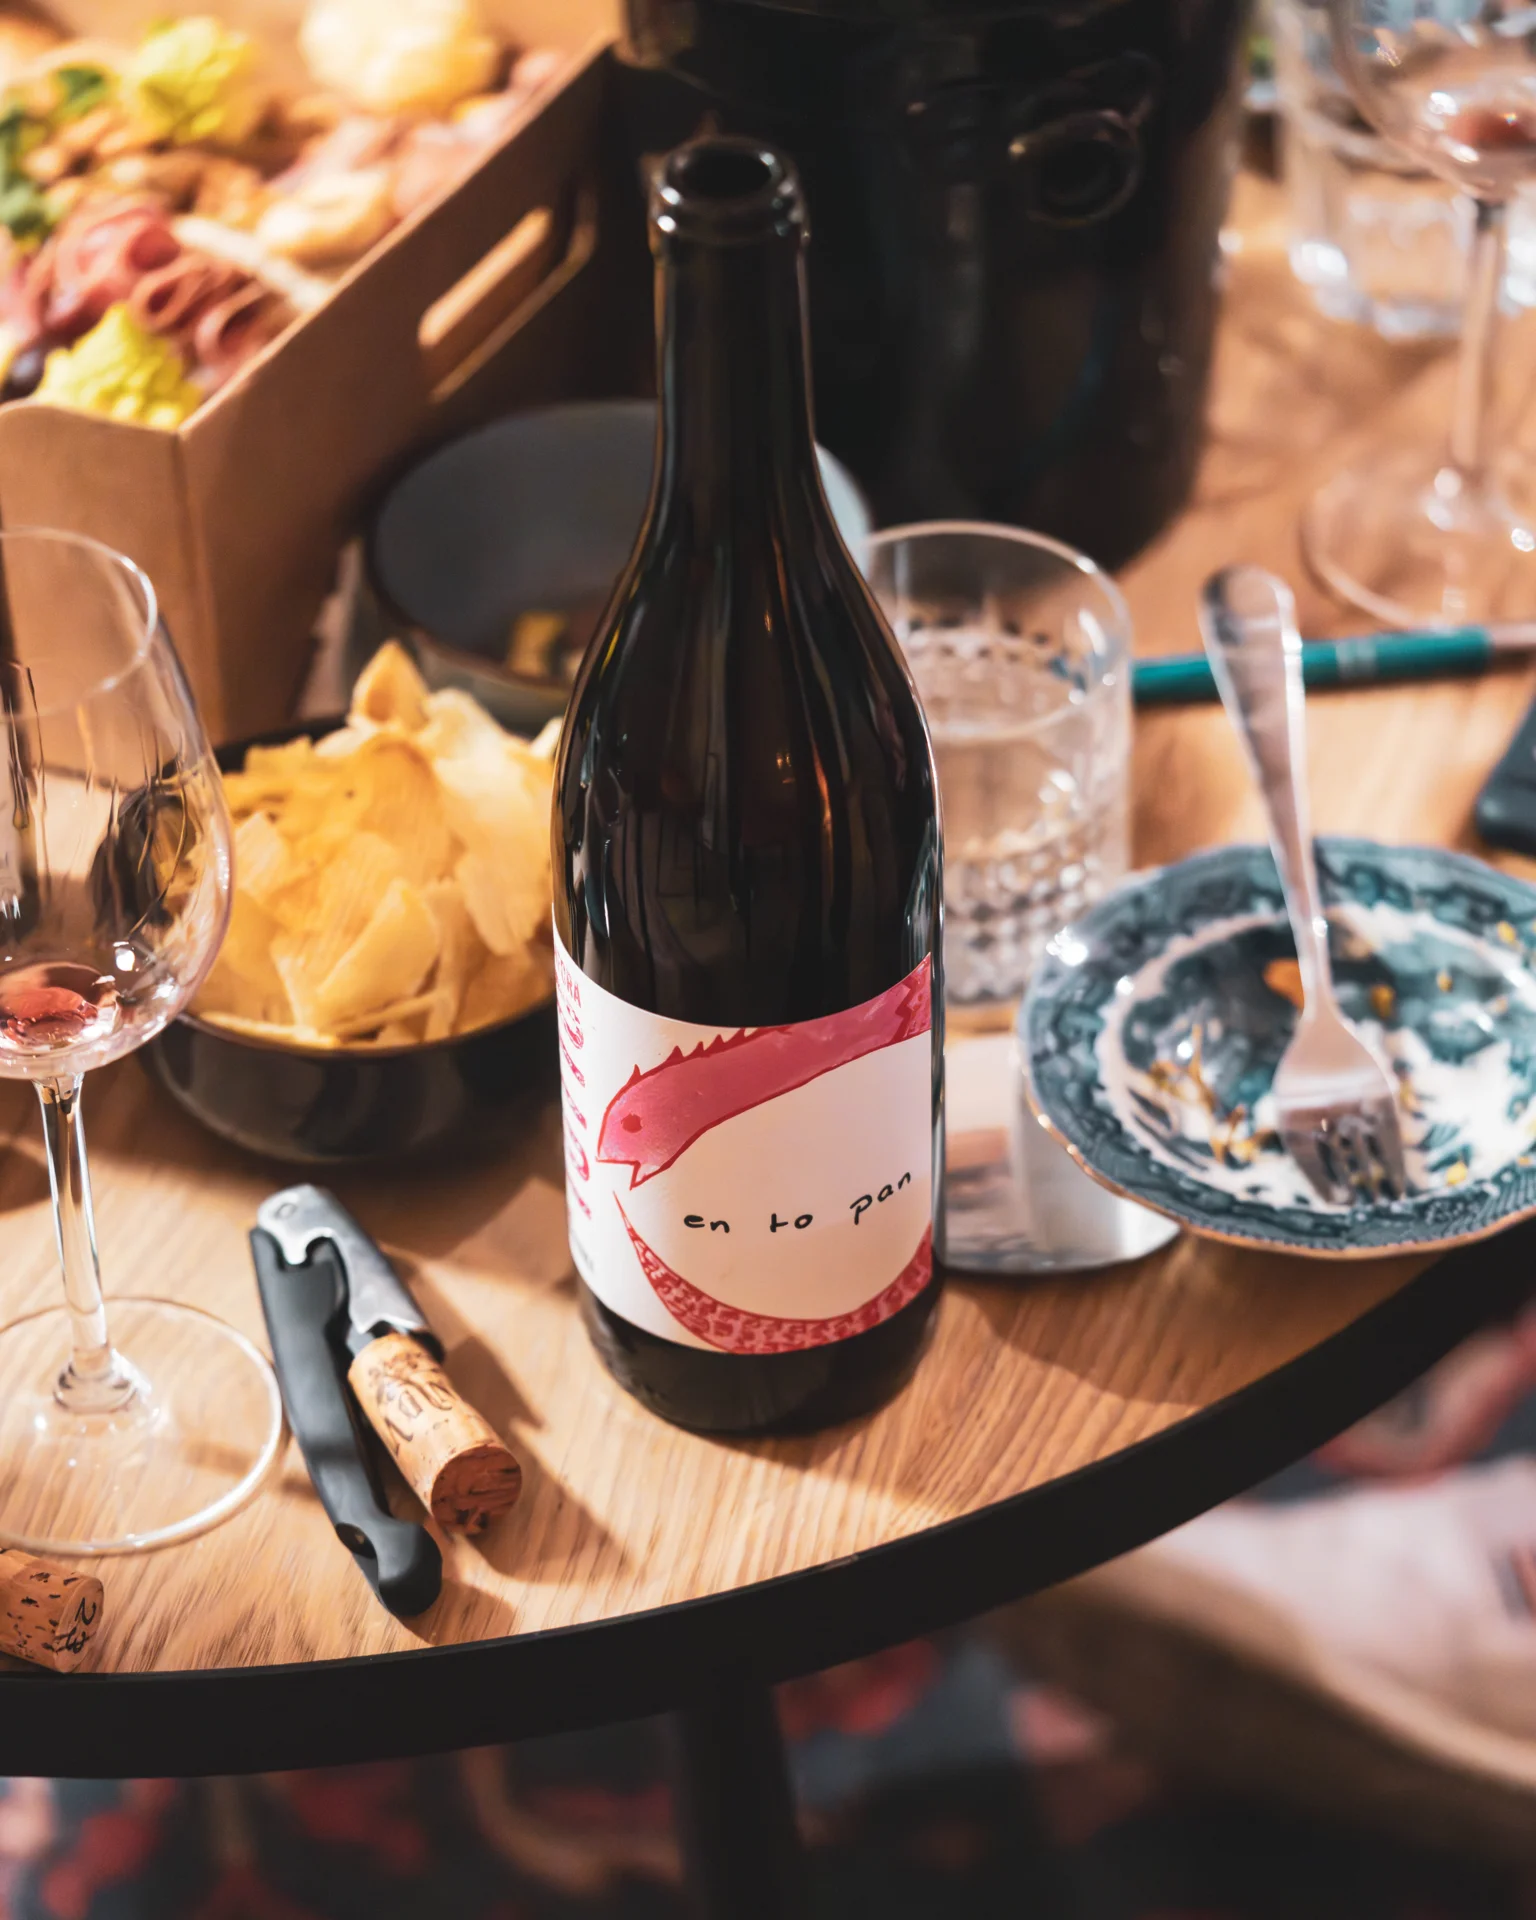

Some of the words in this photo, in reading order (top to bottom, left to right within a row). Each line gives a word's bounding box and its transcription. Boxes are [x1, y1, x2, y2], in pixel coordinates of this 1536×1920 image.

[683, 1214, 730, 1233] en
[770, 1213, 813, 1233] to
[849, 1172, 911, 1225] pan
